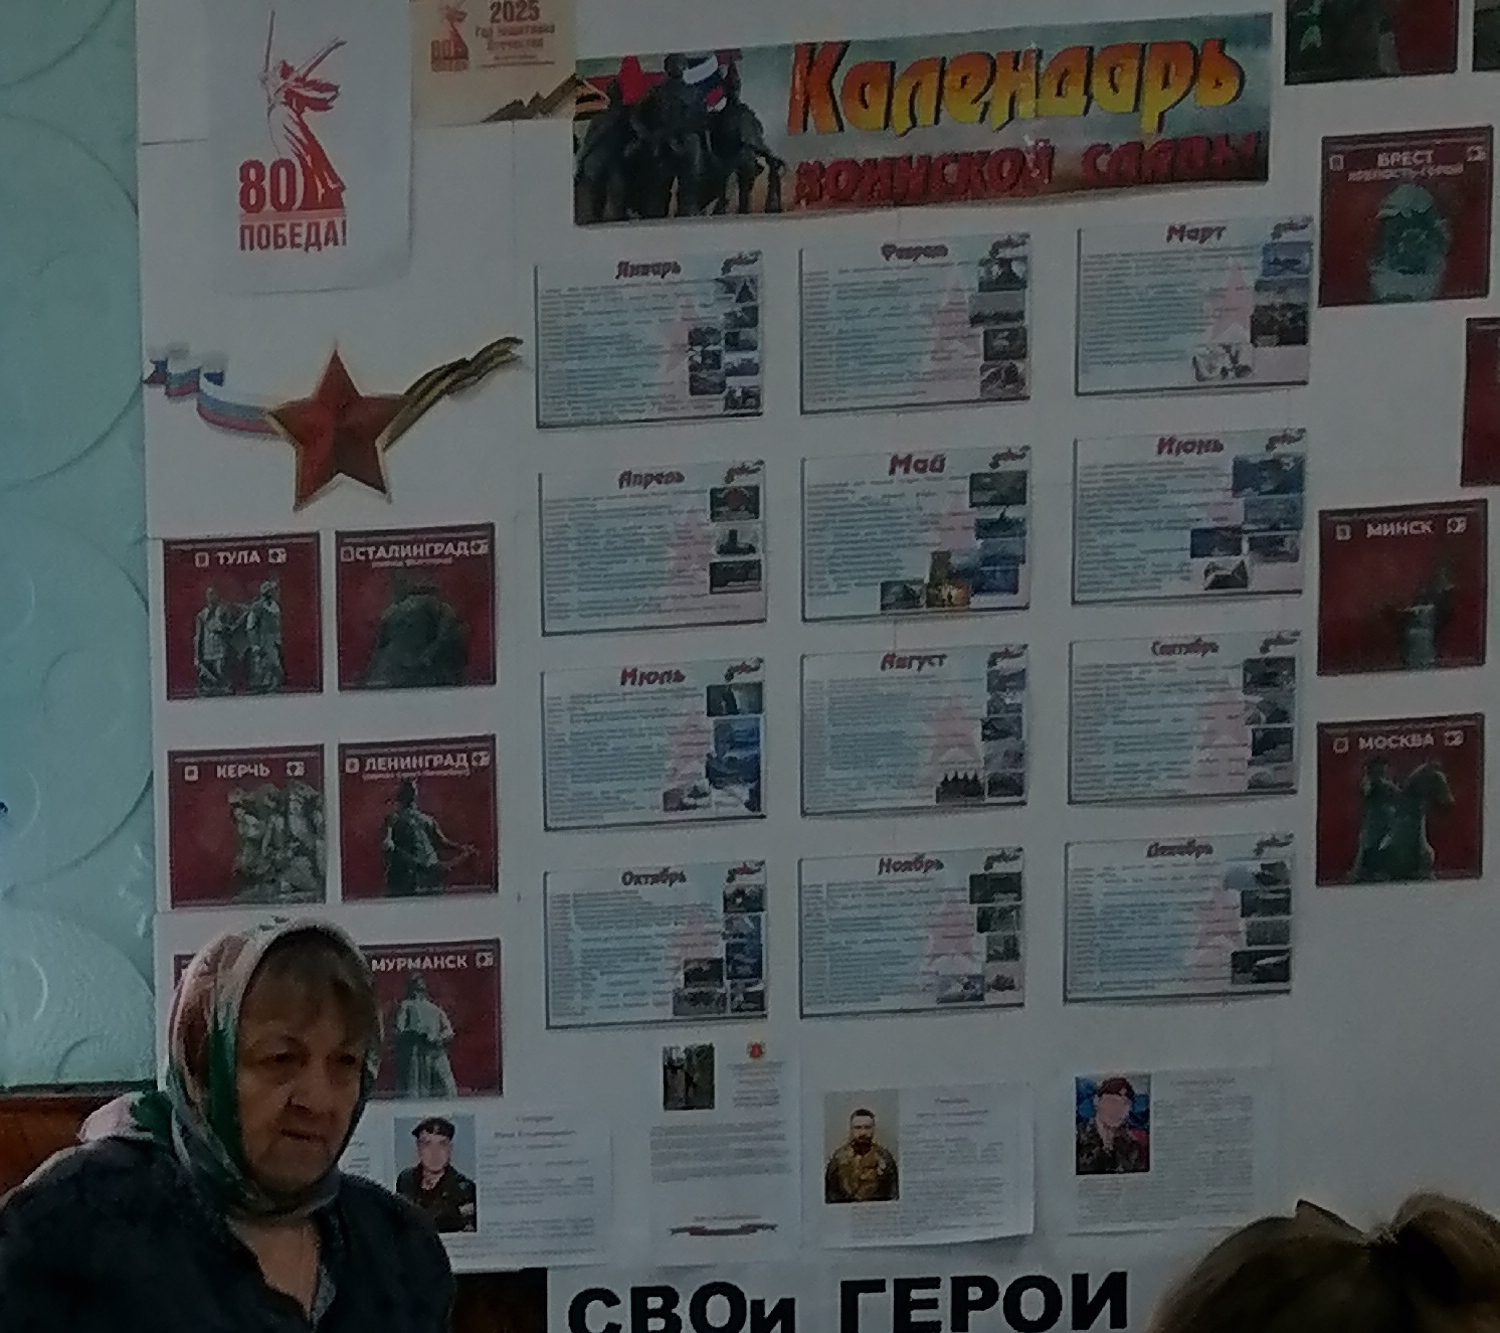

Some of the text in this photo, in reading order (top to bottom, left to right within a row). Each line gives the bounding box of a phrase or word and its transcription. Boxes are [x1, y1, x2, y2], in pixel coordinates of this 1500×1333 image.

[787, 38, 1246, 136] Календарь
[239, 159, 297, 214] 80
[238, 219, 348, 252] ПОБЕДА!
[1166, 224, 1227, 244] Март
[888, 453, 947, 476] Май
[1366, 519, 1435, 538] МИНСК
[217, 548, 262, 566] ТУЛА
[355, 541, 470, 561] СТАЛИНГРАД
[1358, 732, 1435, 750] МОСКВА
[216, 762, 271, 779] КЕРЧЬ
[365, 752, 470, 772] ЛЕНИНГРАД
[877, 853, 944, 875] Ноябрь
[371, 954, 468, 973] МУРМАНСК
